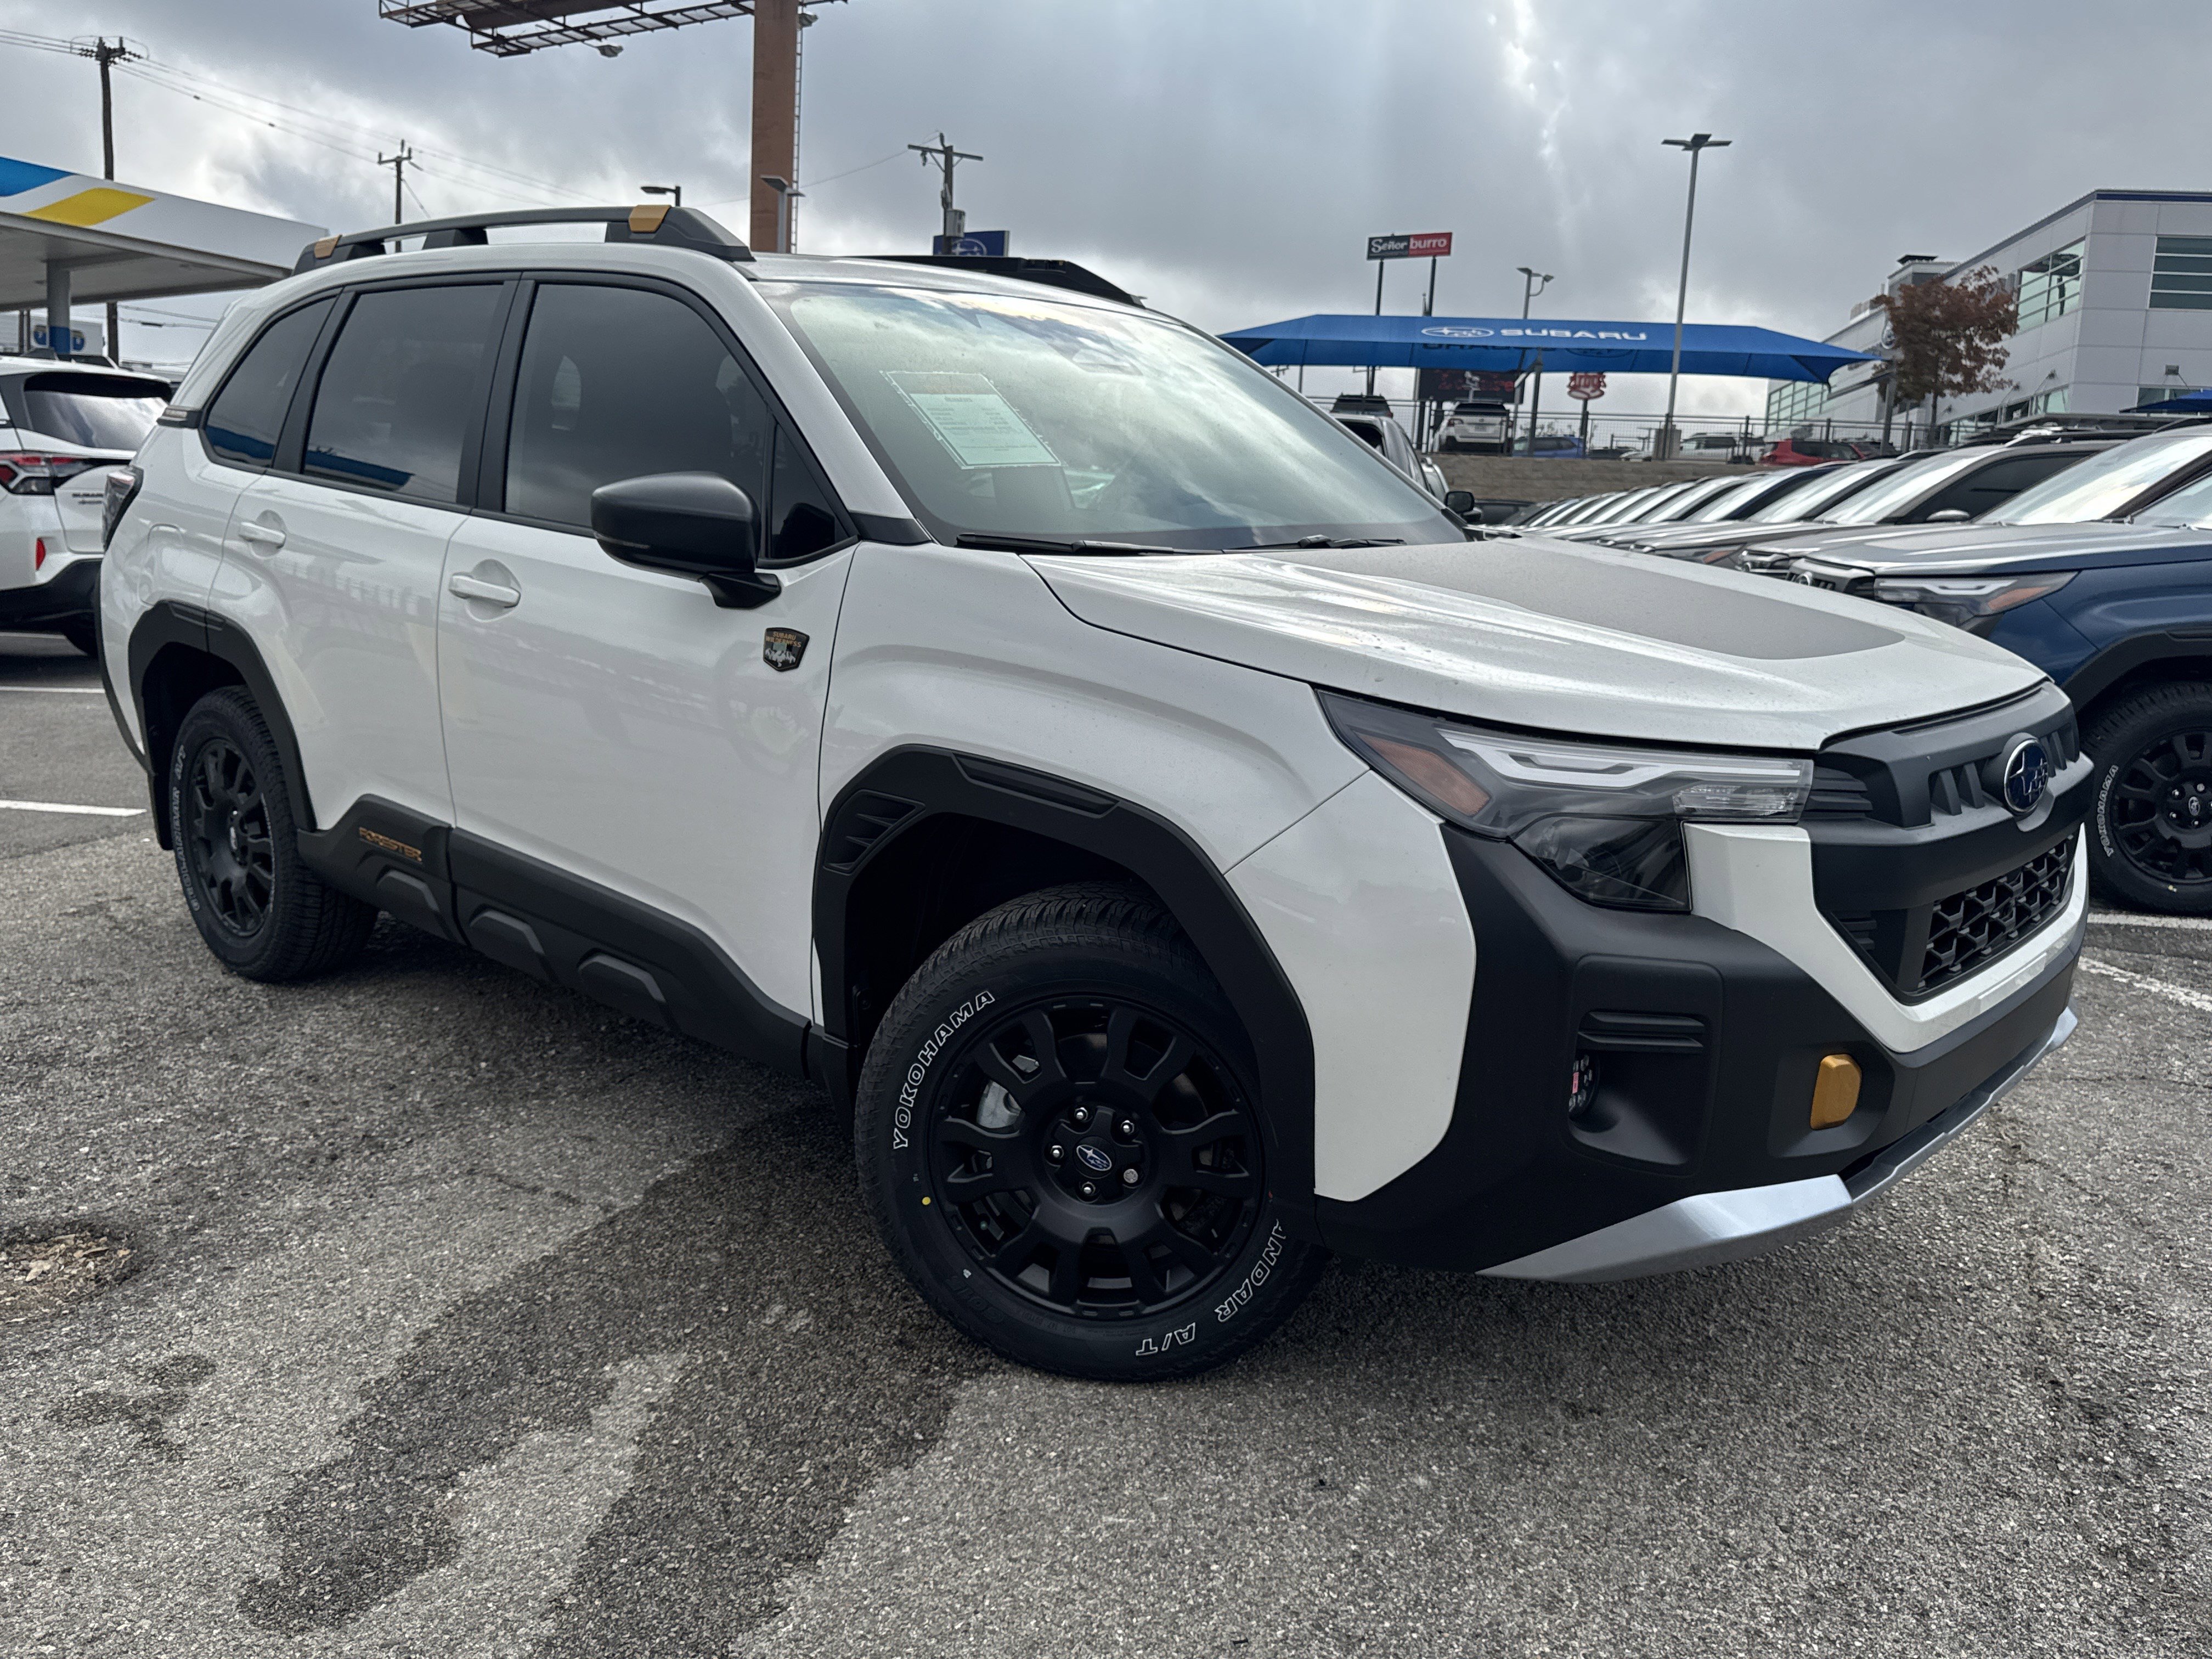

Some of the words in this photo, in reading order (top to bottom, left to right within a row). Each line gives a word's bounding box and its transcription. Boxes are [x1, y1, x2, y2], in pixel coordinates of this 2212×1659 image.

[1371, 238, 1408, 253] Señor
[1410, 237, 1447, 249] burro
[1500, 328, 1647, 341] SUBARU
[766, 636, 802, 647] WILDERNESS
[774, 631, 797, 640] SUBARU
[359, 827, 422, 862] FORESTER
[893, 990, 995, 1150] YOKOHAMA
[1136, 1322, 1196, 1356] A/T
